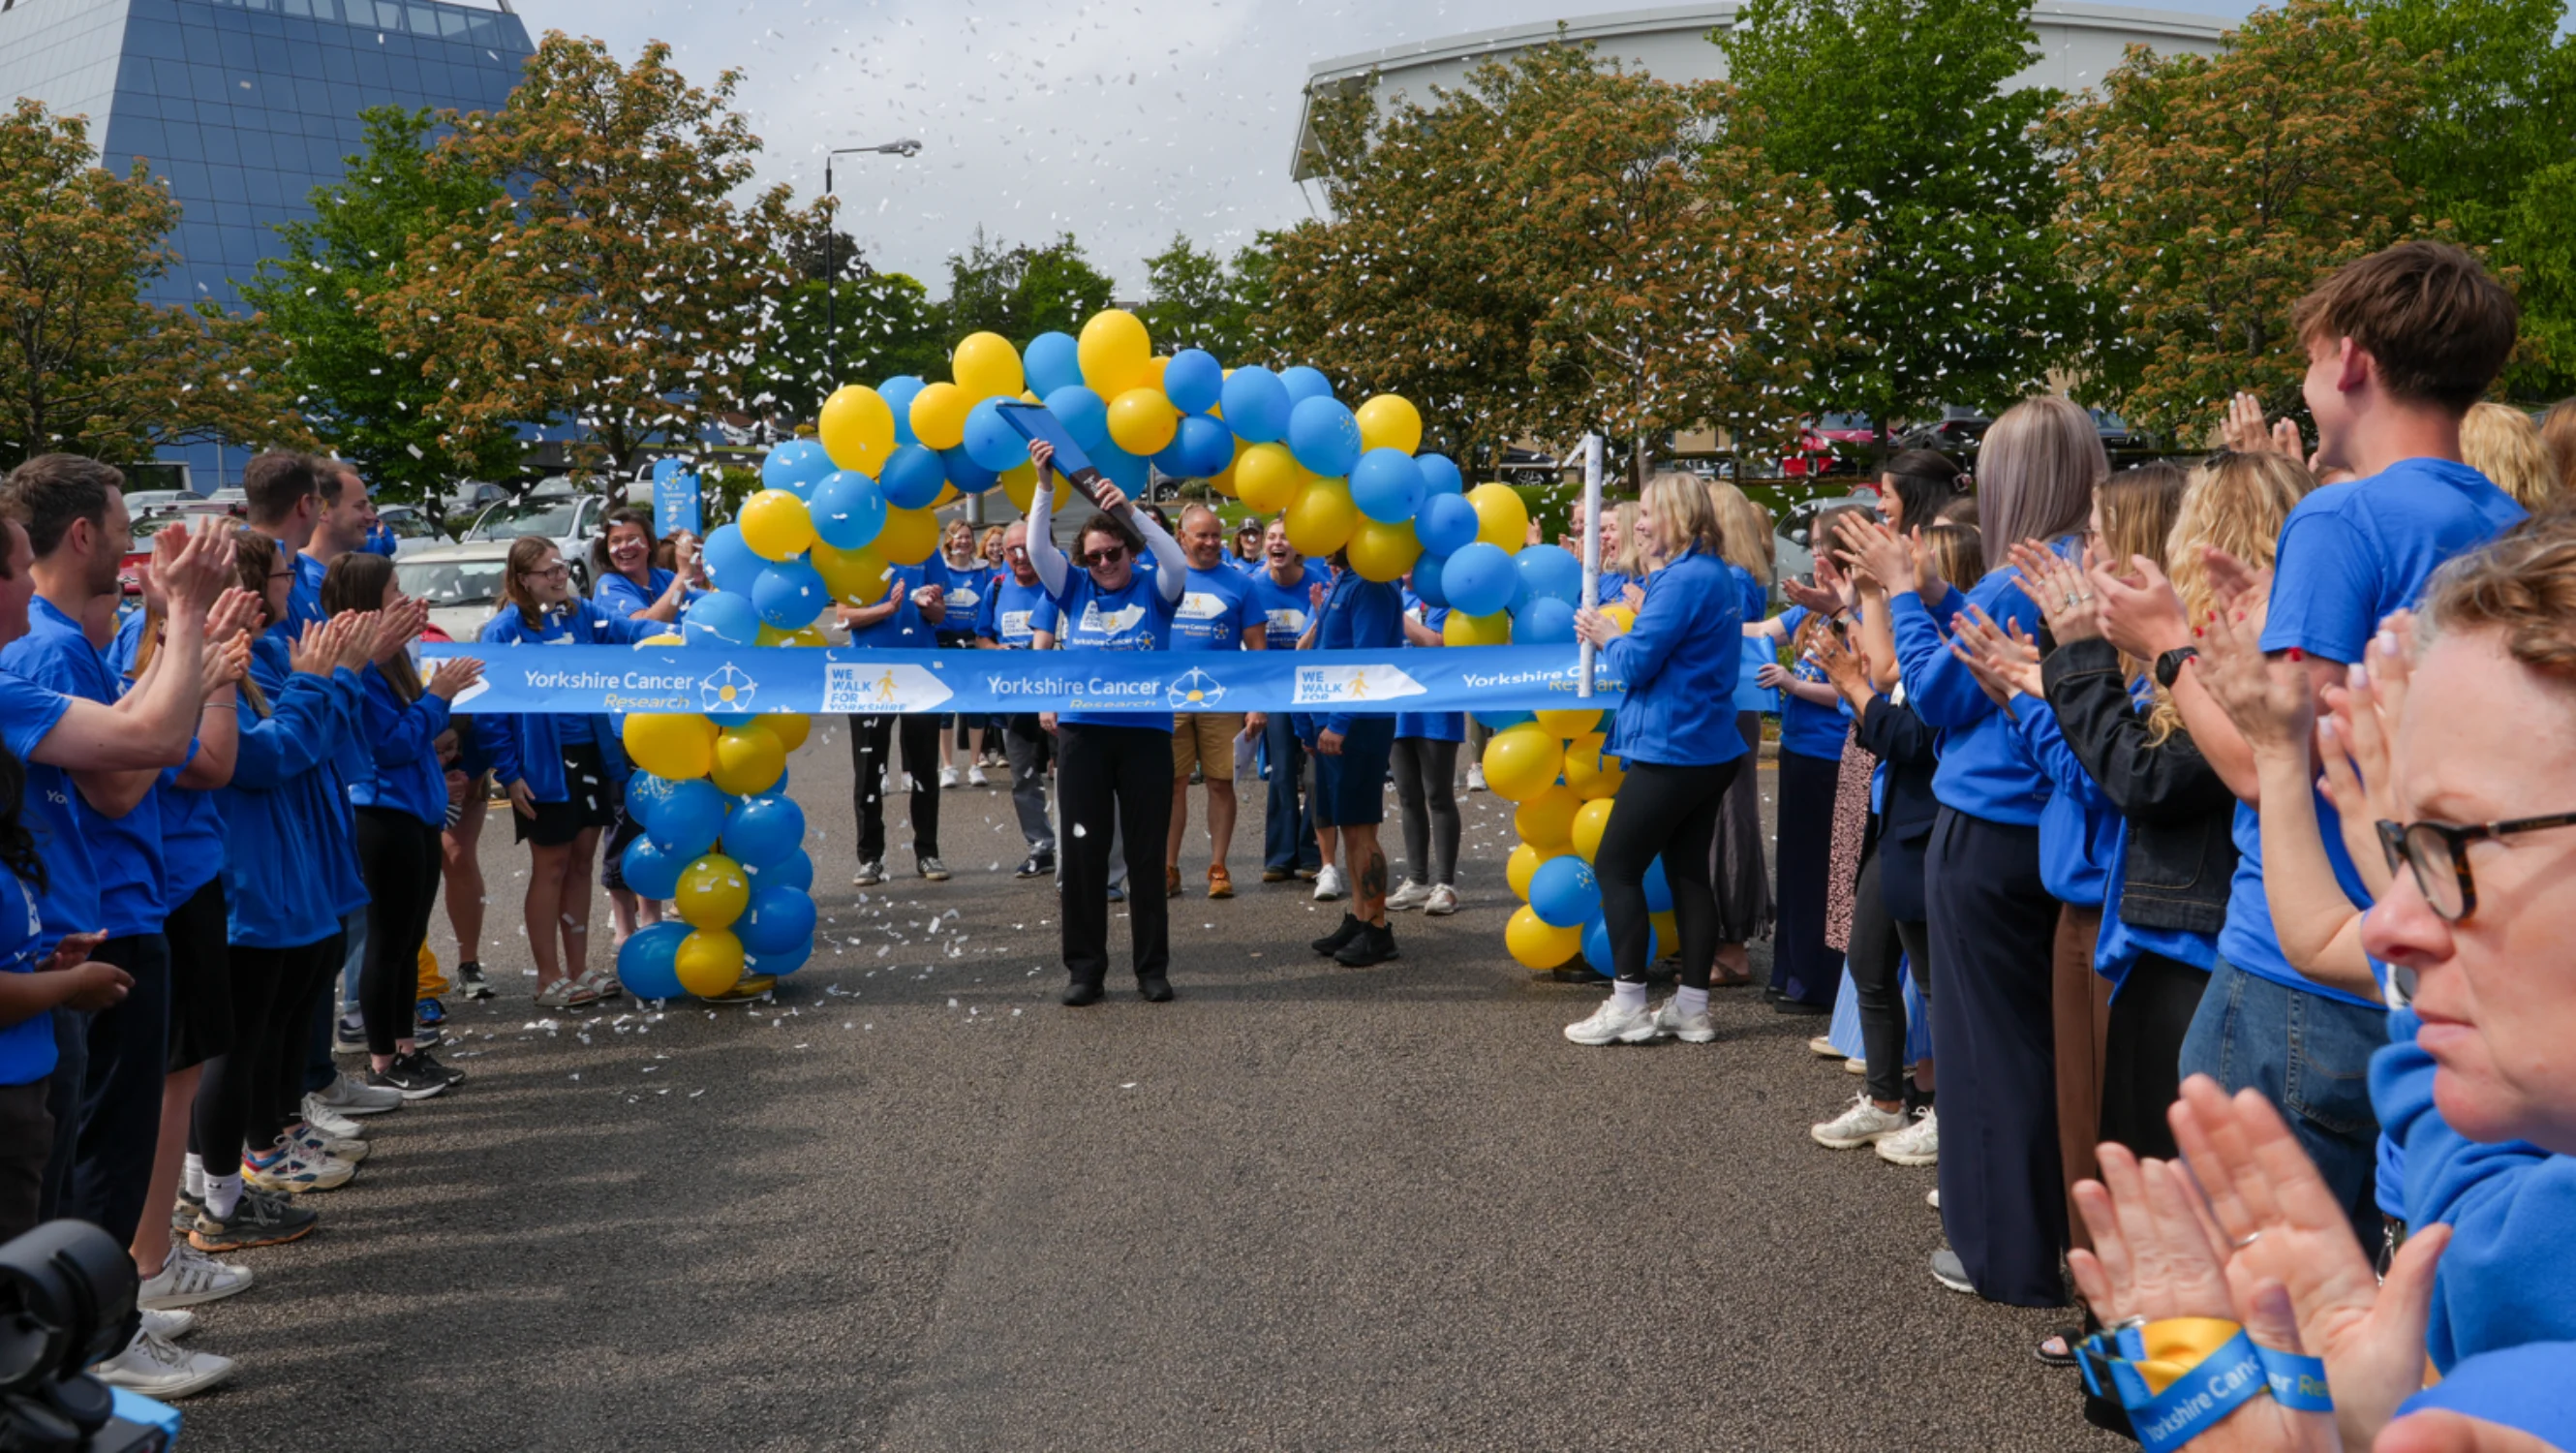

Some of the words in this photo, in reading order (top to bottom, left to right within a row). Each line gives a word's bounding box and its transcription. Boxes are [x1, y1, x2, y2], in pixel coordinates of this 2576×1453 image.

[525, 670, 620, 690] Yorkshire
[624, 671, 695, 690] Cancer
[832, 668, 854, 680] WE
[1302, 670, 1325, 683] WE
[1462, 670, 1563, 688] Yorkshire
[832, 681, 873, 693] WALK
[987, 676, 1085, 696] Yorkshire
[1089, 677, 1160, 696] Cancer
[1302, 683, 1343, 694] WALK
[603, 693, 690, 709] Research
[831, 693, 860, 703] FOR
[1301, 693, 1330, 701] FOR
[829, 702, 907, 711] YORKSHIRE
[1069, 698, 1157, 709] Research
[2142, 1392, 2214, 1444] Yorkshire
